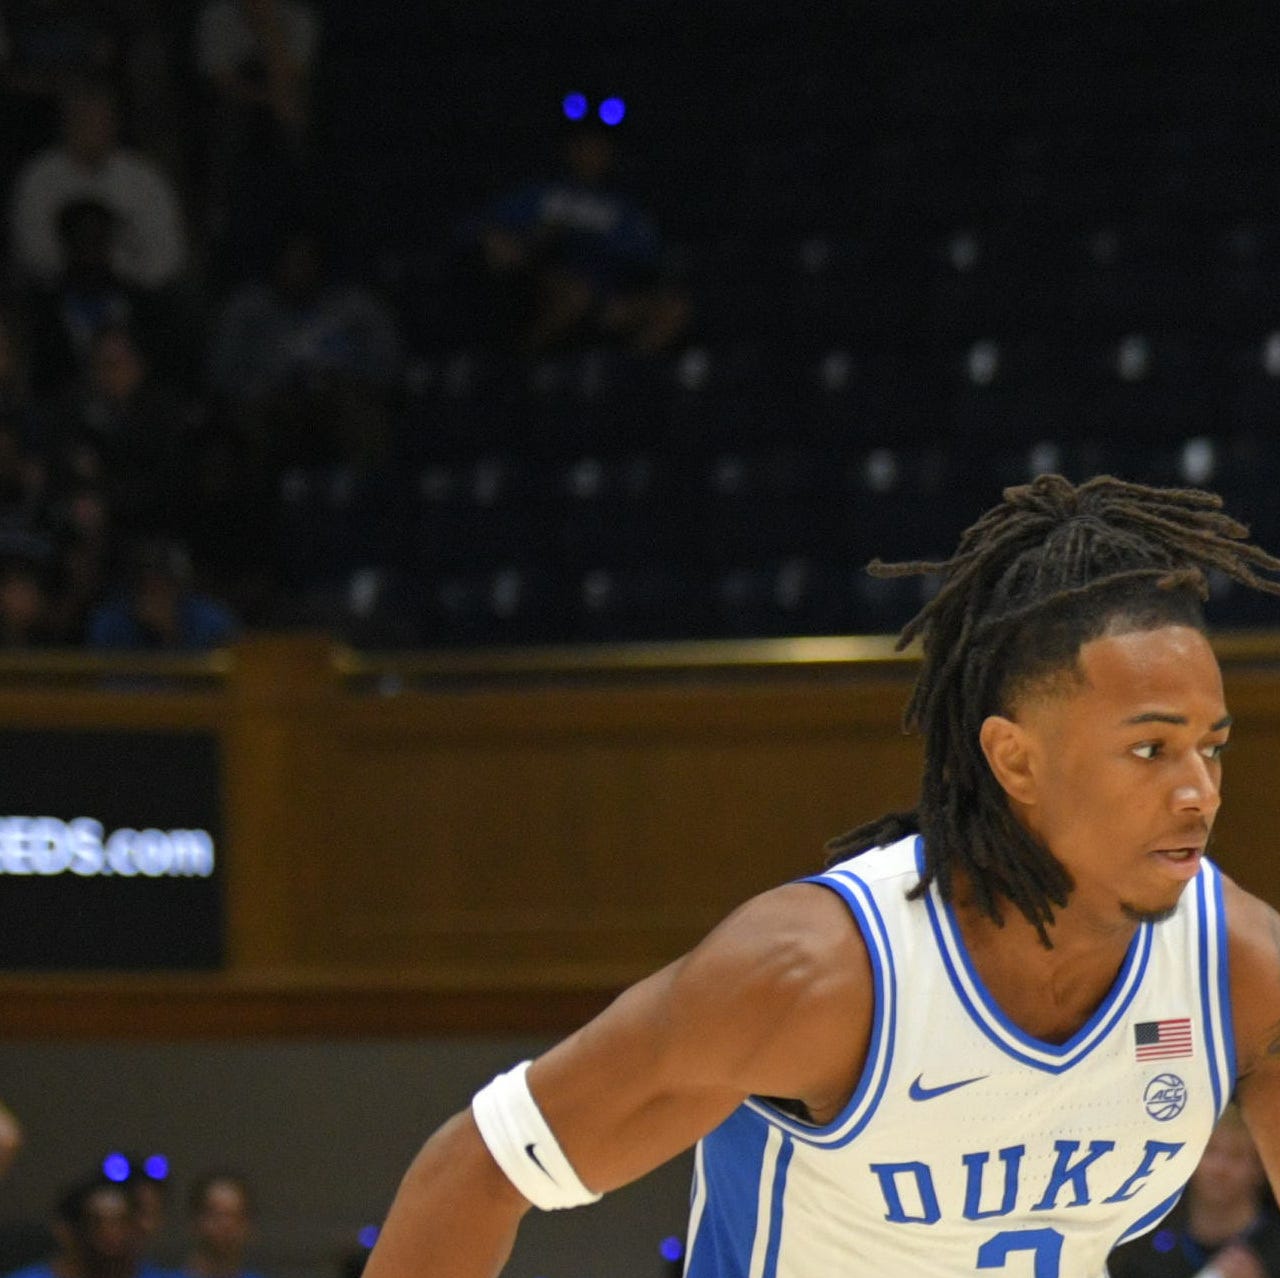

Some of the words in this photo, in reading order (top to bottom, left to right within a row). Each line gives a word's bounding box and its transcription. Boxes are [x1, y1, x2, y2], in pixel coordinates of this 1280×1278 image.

[0, 815, 214, 877] EDS.com
[1152, 1087, 1184, 1103] ACC
[869, 1139, 1184, 1225] DUKE
